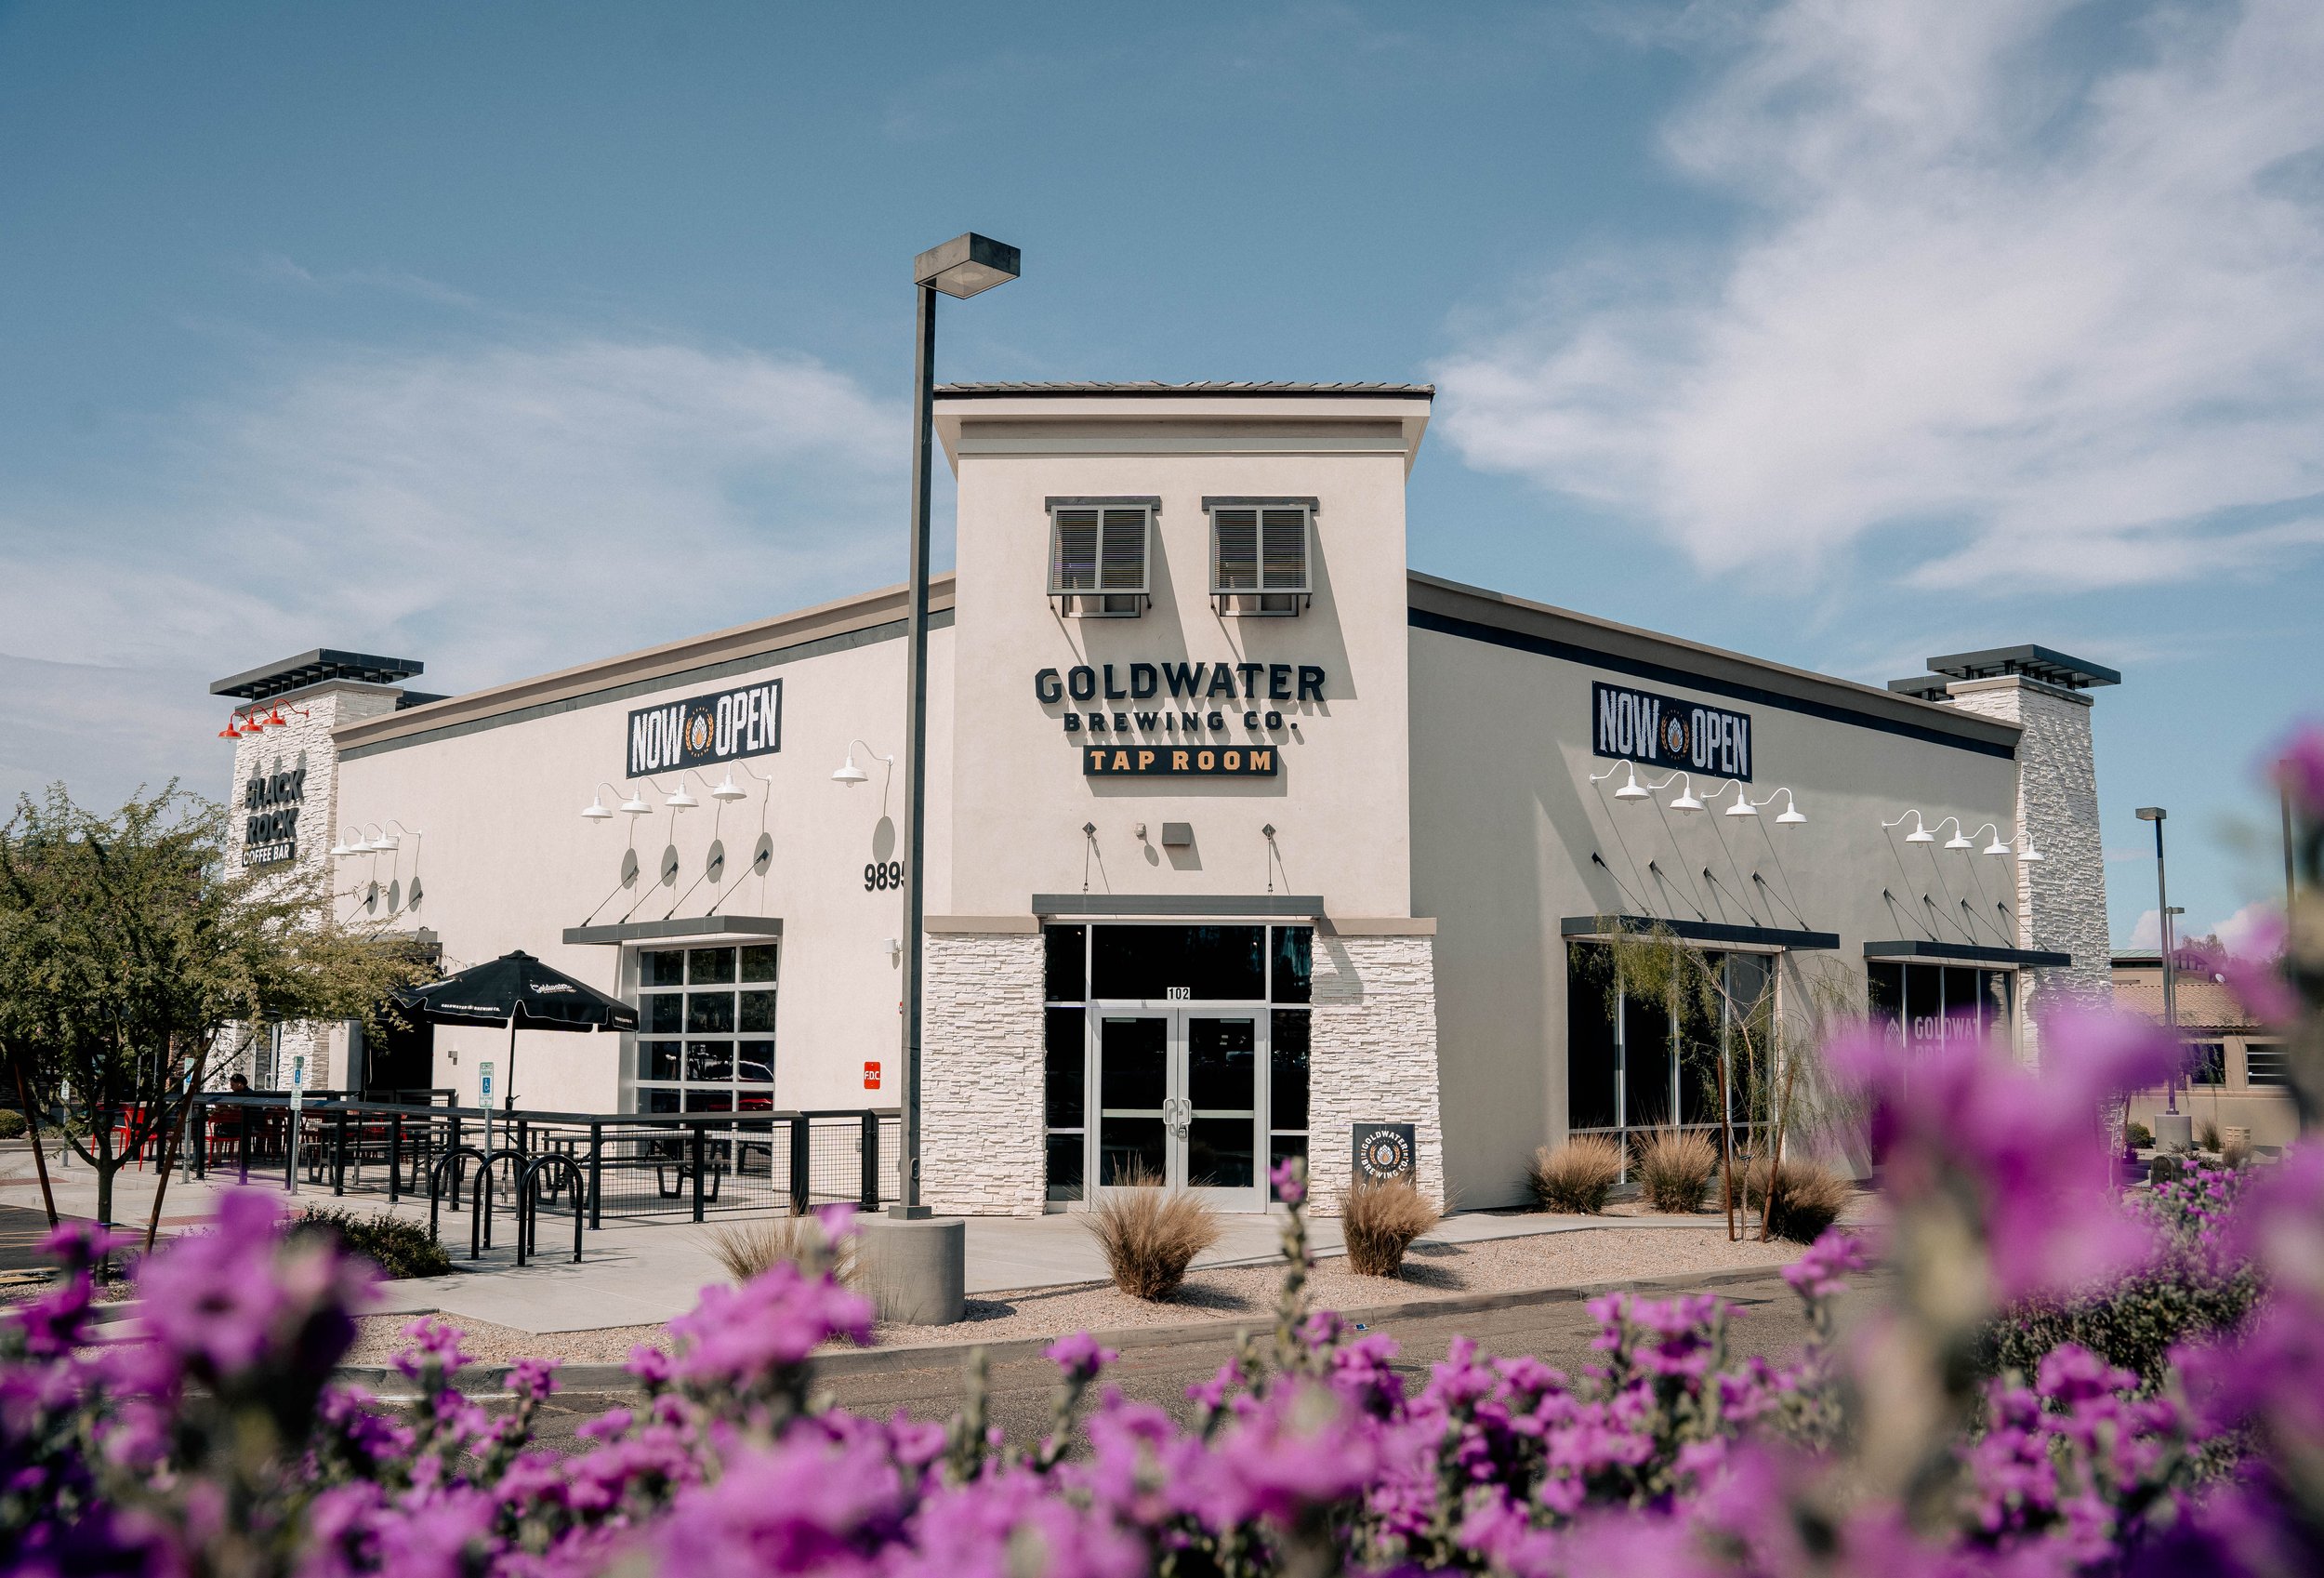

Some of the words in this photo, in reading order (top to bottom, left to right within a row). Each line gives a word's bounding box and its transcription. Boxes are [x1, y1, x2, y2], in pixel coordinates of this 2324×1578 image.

[1035, 662, 1326, 704] GOLDWATER
[632, 704, 686, 773] NOW
[715, 684, 777, 756] OPEN
[1063, 711, 1224, 732] BREWING
[1244, 710, 1298, 731] CO.
[1600, 689, 1659, 759] NOW
[1692, 709, 1747, 776] OPEN
[1090, 750, 1155, 771] TAP
[1172, 750, 1272, 771] ROOM
[244, 769, 306, 809] BLACK
[245, 808, 299, 844] ROCK
[243, 847, 272, 865] COFFEE
[272, 844, 290, 860] BAR
[1169, 988, 1189, 1000] 102
[1361, 1130, 1408, 1150] GOLDWATER
[1361, 1158, 1399, 1179] BREWING
[1398, 1159, 1409, 1172] CO.
